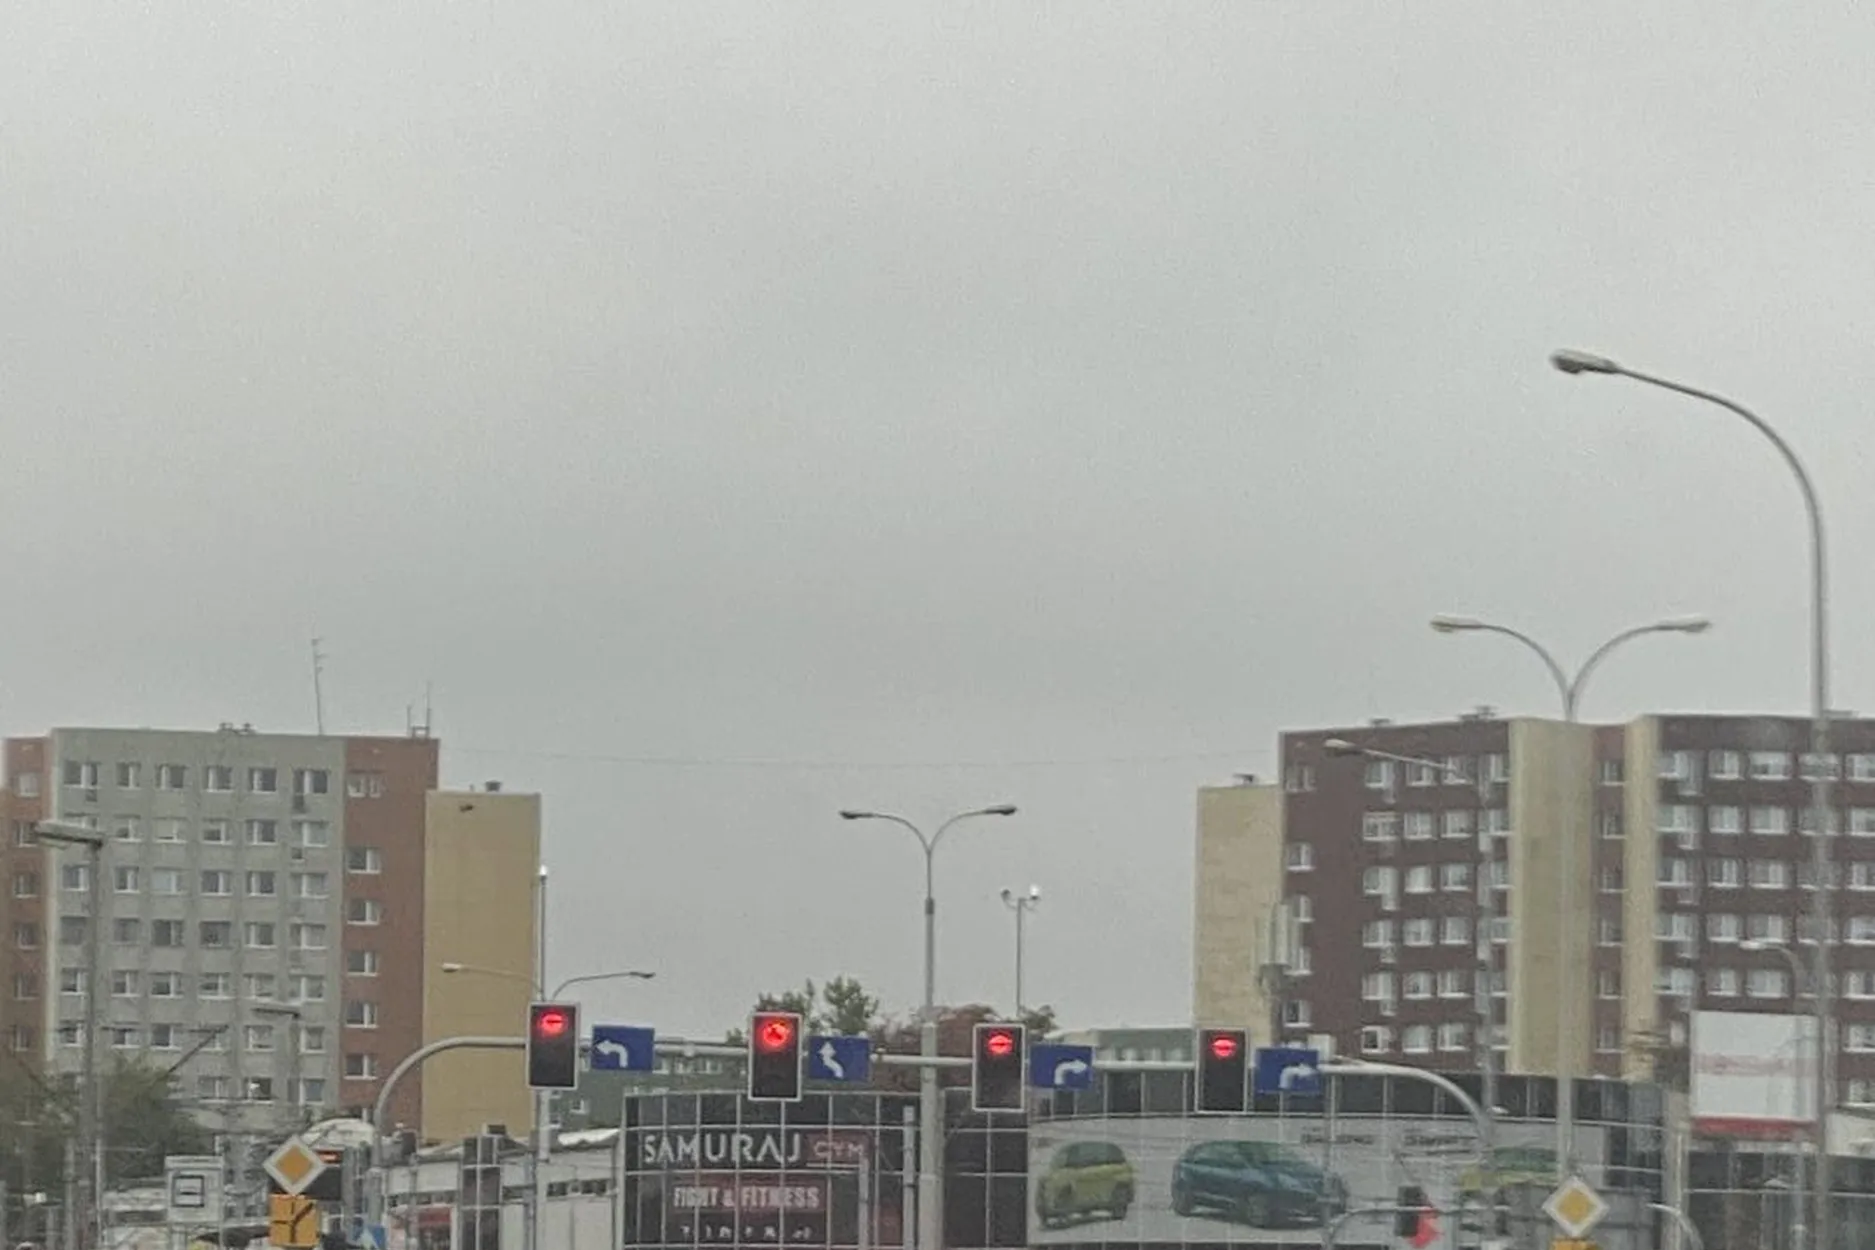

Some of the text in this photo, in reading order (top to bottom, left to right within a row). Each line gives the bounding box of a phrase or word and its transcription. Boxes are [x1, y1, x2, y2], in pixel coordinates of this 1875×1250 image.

[643, 1132, 801, 1164] SAMURAJ
[674, 1186, 719, 1208] FIGHT
[741, 1186, 820, 1208] FITNESS
